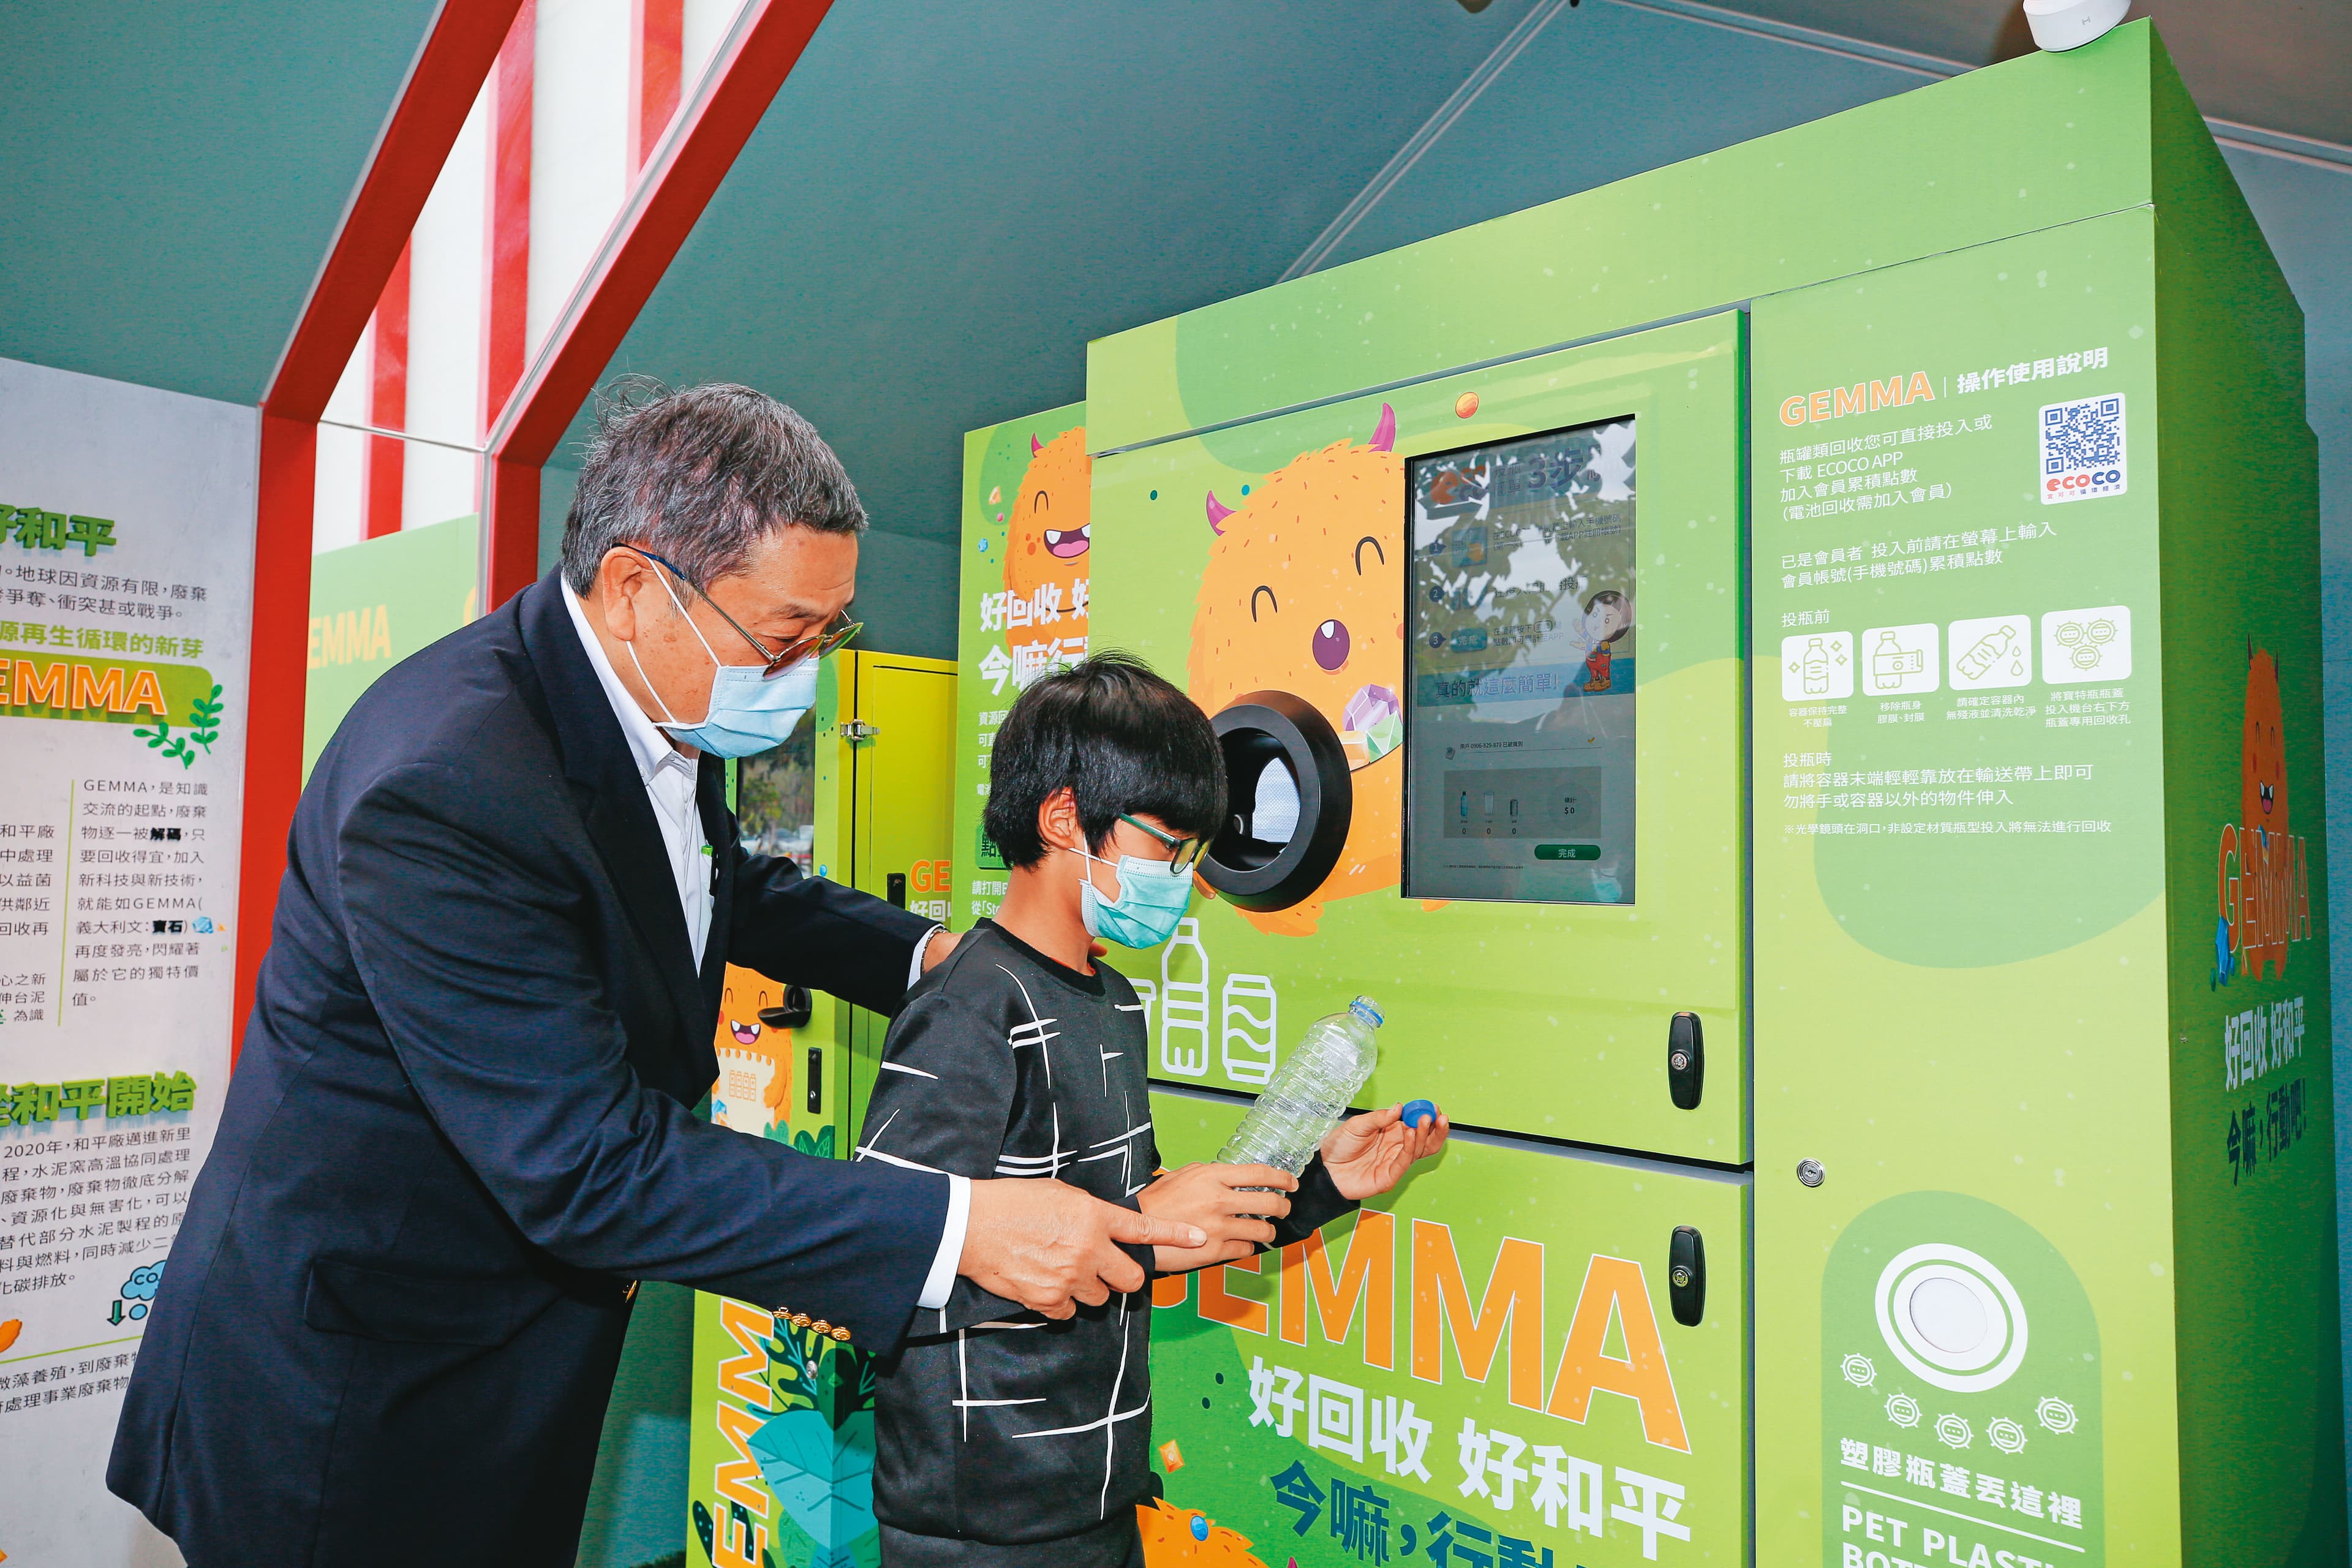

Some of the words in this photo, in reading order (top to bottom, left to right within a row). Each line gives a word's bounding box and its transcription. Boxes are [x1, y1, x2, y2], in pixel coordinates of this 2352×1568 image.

[1779, 371, 1936, 427] GEMMA
[1957, 346, 2108, 394] 操作使用說明
[1779, 413, 1993, 464] 瓶罐類回收您可直接投入或
[1780, 467, 1917, 502] 加入會員累積點數
[1781, 465, 1812, 483] 下載
[1818, 457, 1869, 477] ECOCO
[1872, 451, 1903, 469] APP
[1781, 545, 1863, 570] 已是會員者
[1871, 521, 2057, 559] 投入前請在螢幕上輸入
[0, 565, 208, 602] 。地球因資源有限，廢棄
[0, 588, 183, 620] 爭奪、衝突甚或戰爭。
[980, 582, 1063, 633] 好回收
[1781, 609, 1830, 627] 投瓶前
[1783, 752, 1832, 767] 投瓶時
[1784, 790, 2013, 809] 勿將手或容器以外的物件伸入
[1558, 849, 1576, 858] 完成
[910, 859, 951, 893] GE
[2218, 823, 2312, 954] GEMMA
[910, 900, 951, 922] 好回
[2225, 1005, 2267, 1092] 好回收
[2271, 996, 2305, 1069] 好和平
[0, 1071, 197, 1127] 和平開始
[0, 1234, 177, 1273] 料與燃料，同時減少二
[135, 1272, 160, 1286] CO
[1152, 1208, 1692, 1455] EMMA
[0, 1376, 129, 1414] 處理事業廢棄物
[1248, 1355, 1432, 1483] 好回收
[1457, 1417, 1691, 1562] 好和平
[1840, 1438, 2082, 1529] 塑膠瓶蓋丟這裡
[1842, 1504, 1908, 1547] PET
